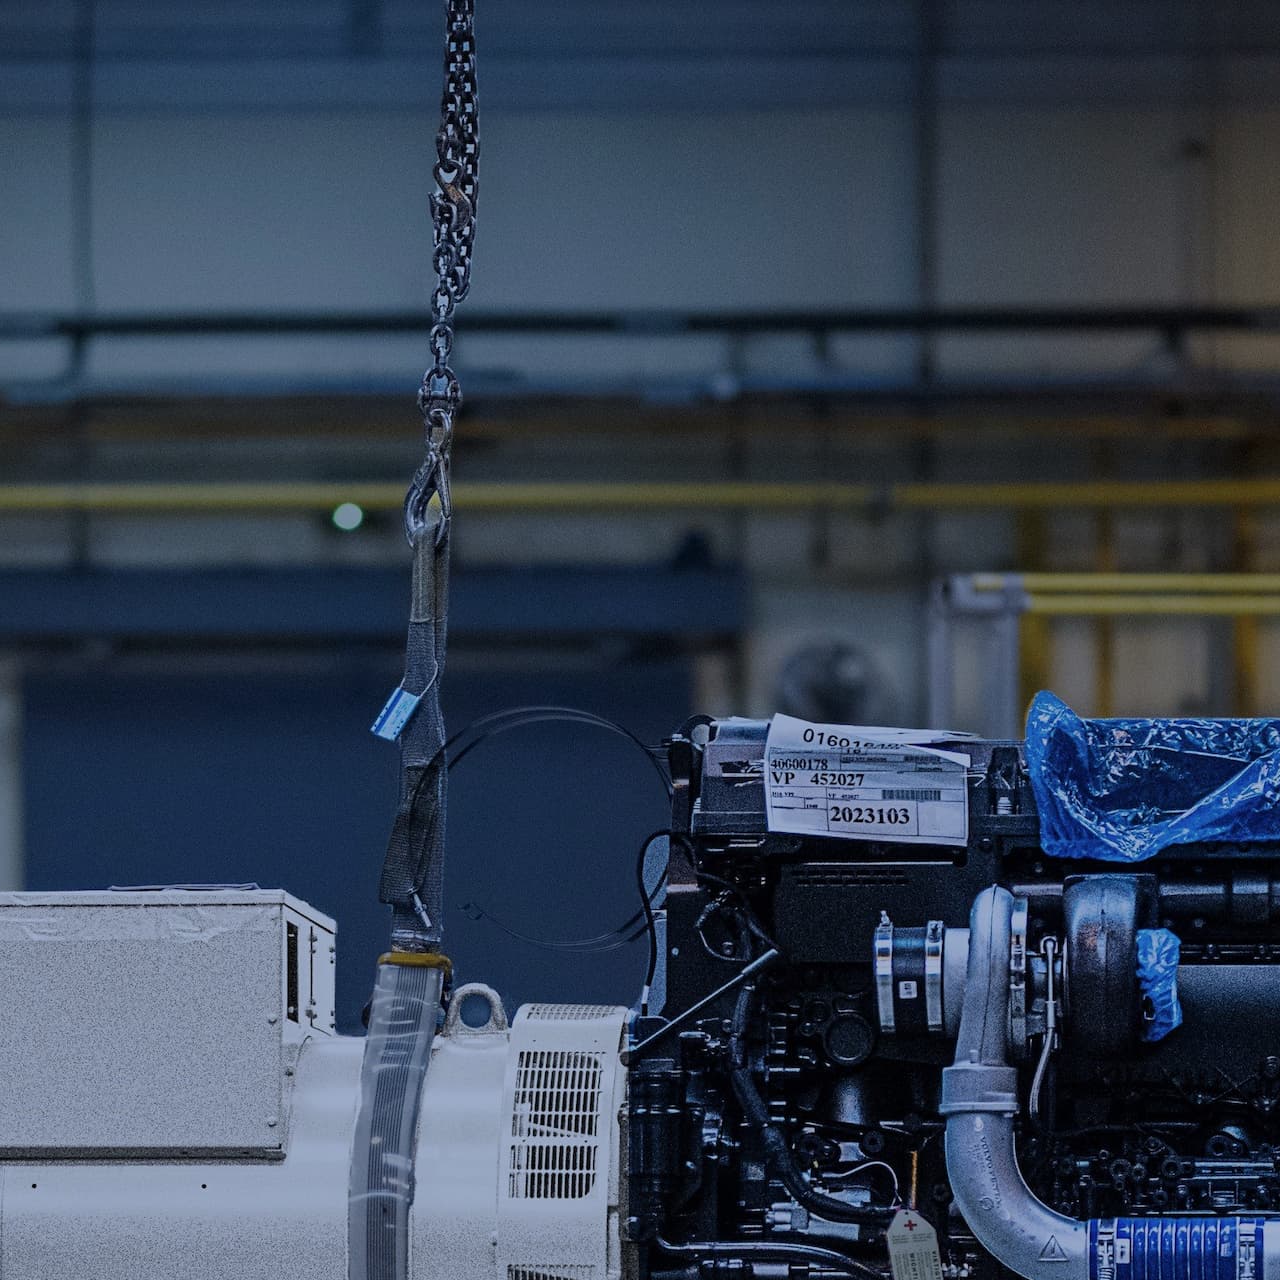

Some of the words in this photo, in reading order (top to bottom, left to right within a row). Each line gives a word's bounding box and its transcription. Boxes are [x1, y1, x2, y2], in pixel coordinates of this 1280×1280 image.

[771, 771, 795, 785] VP
[809, 772, 865, 787] 452027
[830, 806, 911, 825] 2023103
